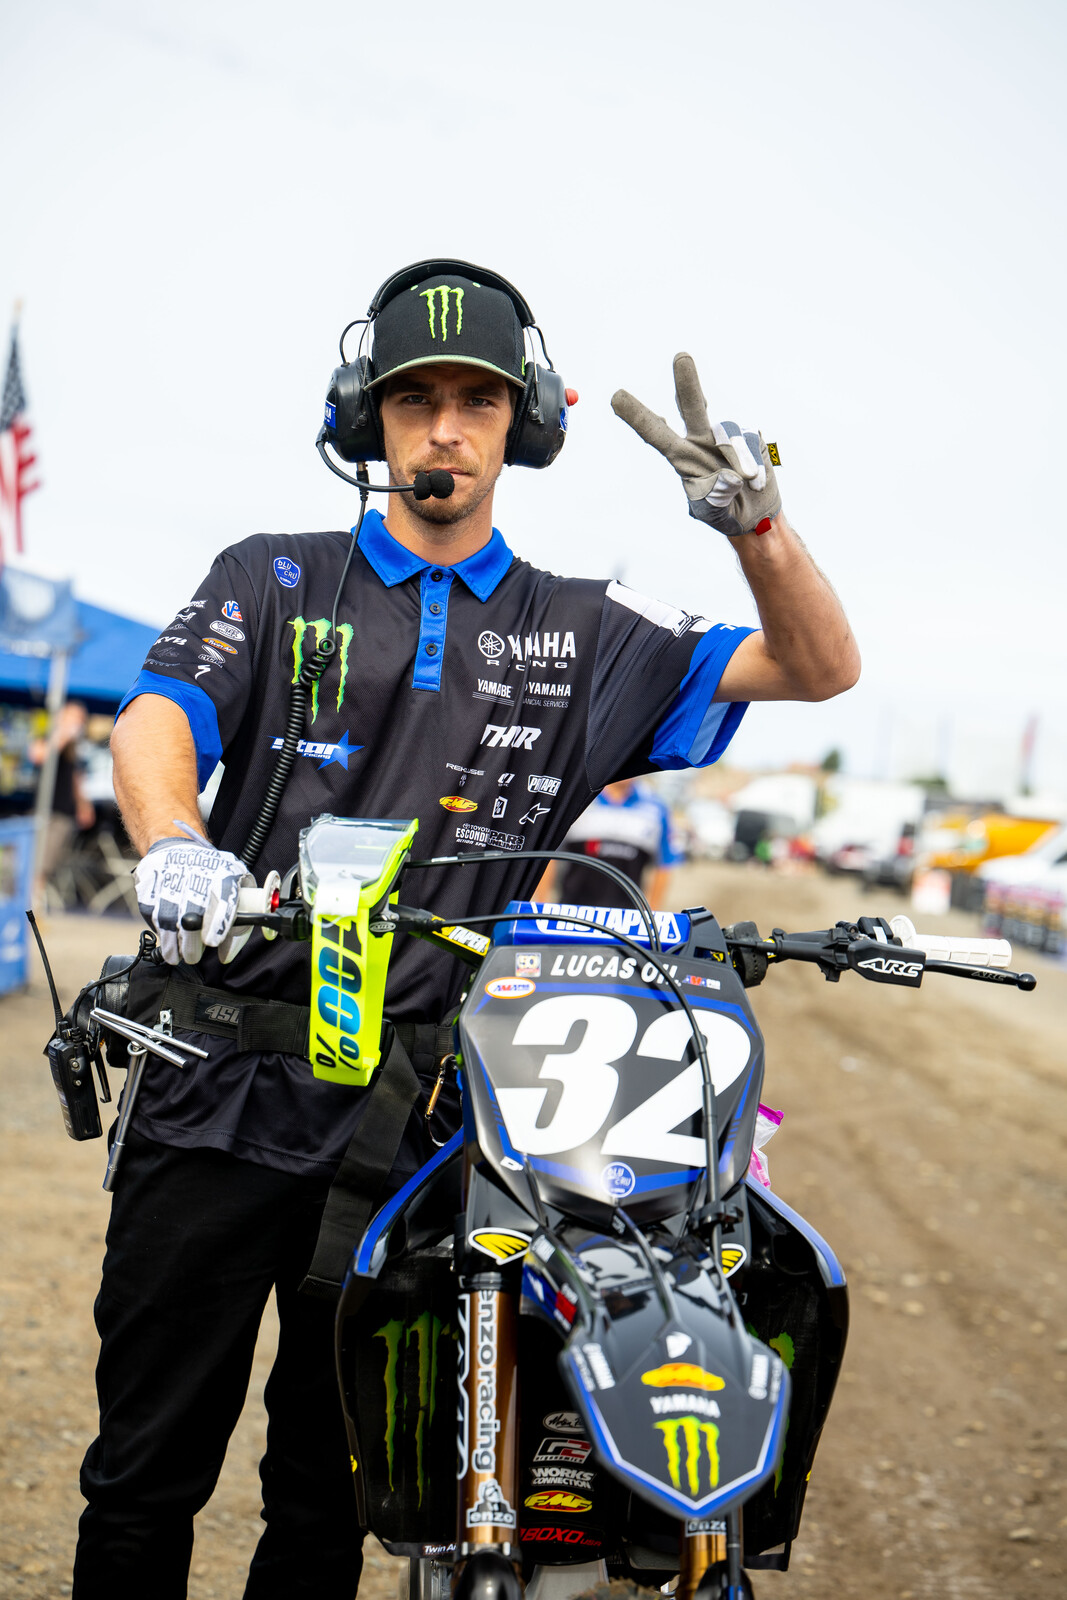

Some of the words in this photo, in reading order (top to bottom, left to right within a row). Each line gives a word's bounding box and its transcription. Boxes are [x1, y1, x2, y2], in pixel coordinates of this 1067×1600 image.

[477, 678, 513, 698] YAMABE
[528, 681, 571, 697] YAMAHA
[542, 699, 569, 709] SERVICES
[455, 827, 489, 843] ESCONDI
[550, 954, 638, 980] LUCAS
[857, 957, 924, 979] ARC
[971, 969, 1007, 983] ARC
[315, 917, 363, 1072] 100%
[494, 993, 751, 1168] 32
[531, 1467, 595, 1482] WORKS
[532, 1477, 592, 1490] CONNECTION
[525, 1492, 593, 1509] FMF
[469, 1511, 514, 1524] enzo
[424, 1544, 447, 1556] Twin
